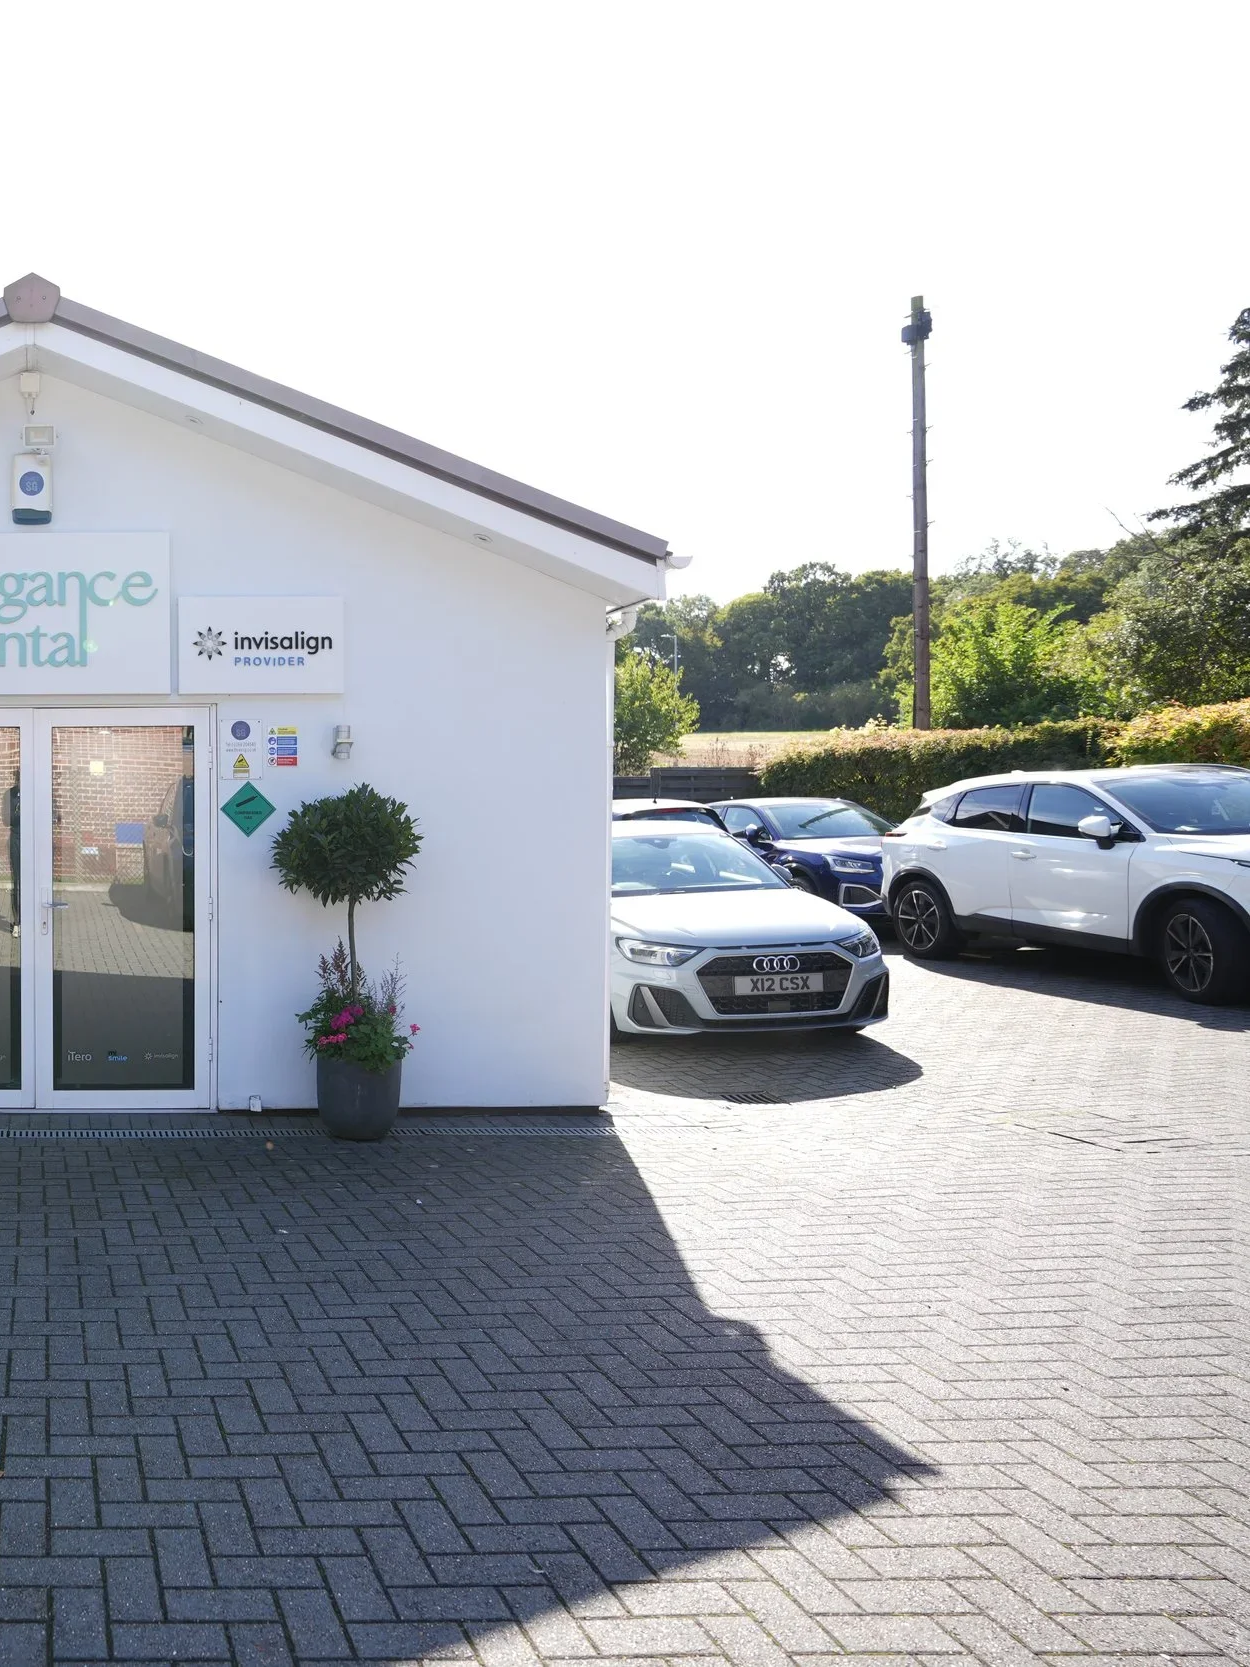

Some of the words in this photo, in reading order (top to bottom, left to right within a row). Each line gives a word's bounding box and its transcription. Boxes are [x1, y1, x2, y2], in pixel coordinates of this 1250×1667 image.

[234, 631, 333, 655] invisalign
[234, 656, 305, 666] PROVIDER
[750, 978, 776, 992] X12
[779, 976, 810, 991] CSX
[68, 1049, 92, 1061] iTero
